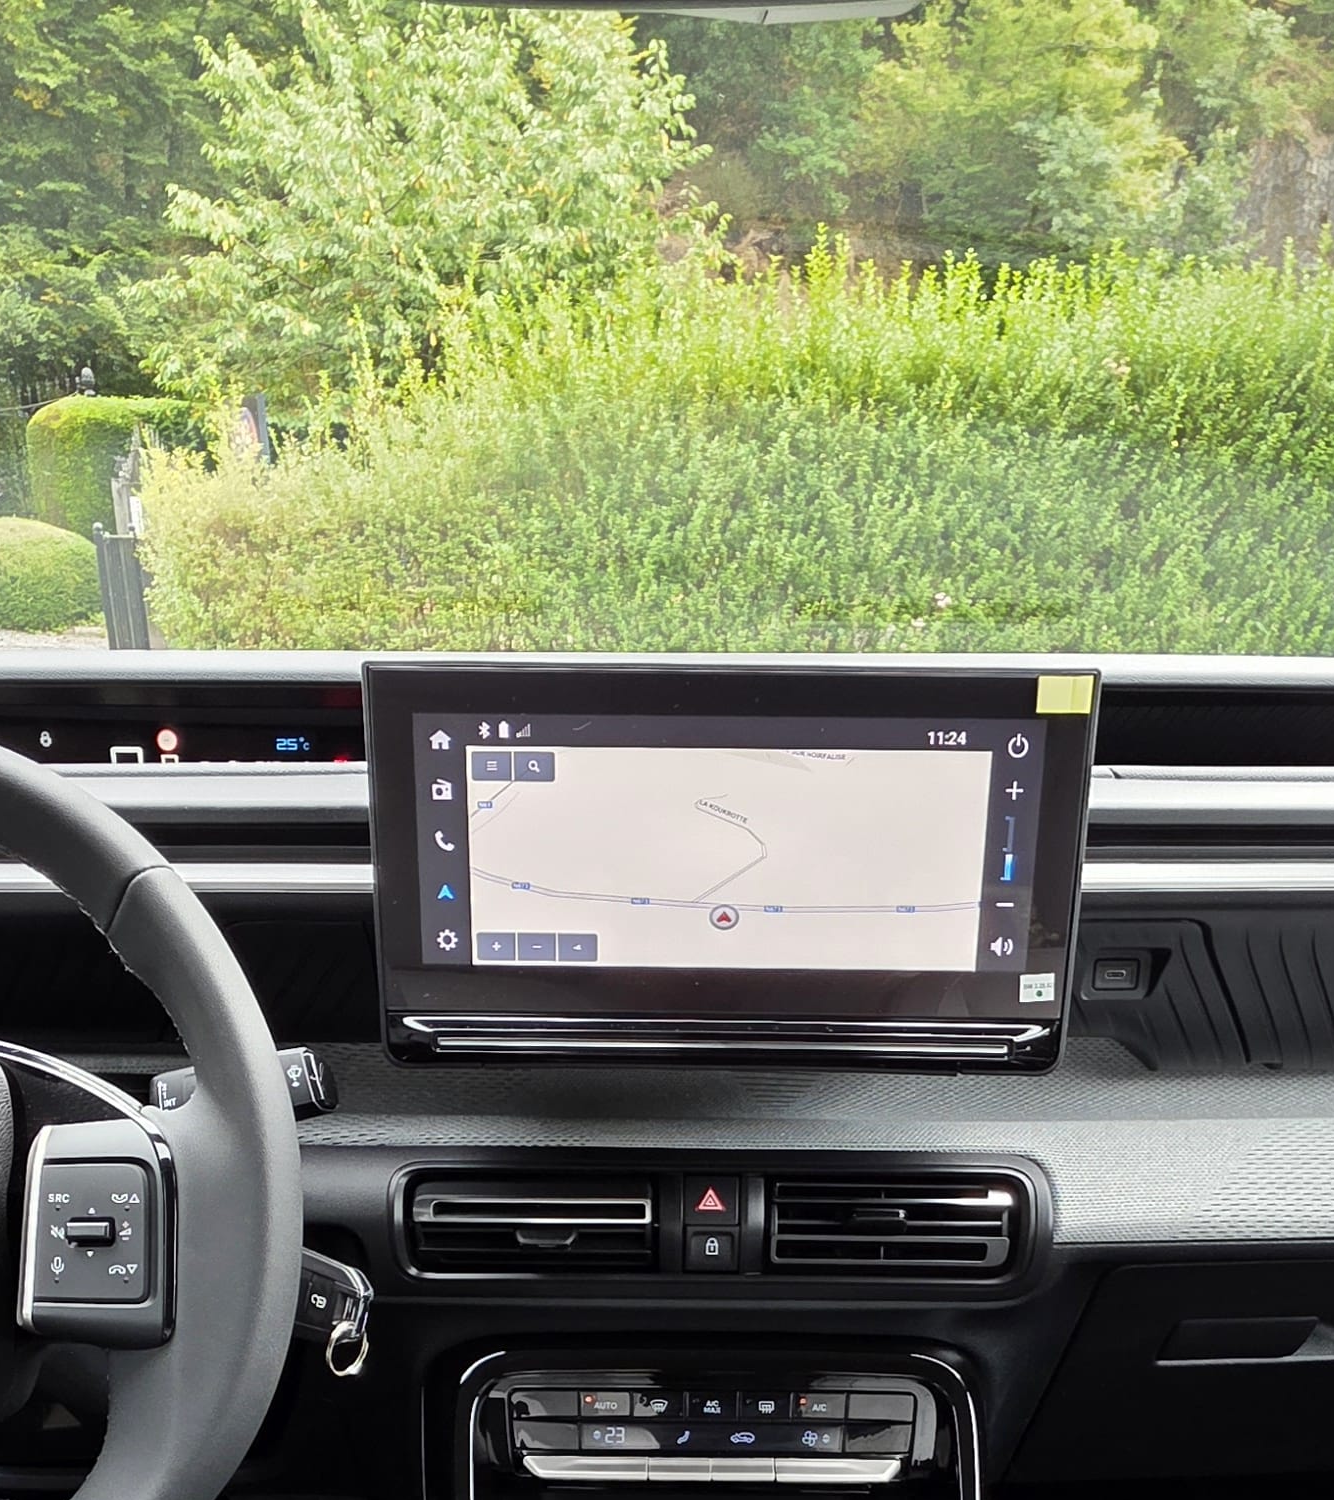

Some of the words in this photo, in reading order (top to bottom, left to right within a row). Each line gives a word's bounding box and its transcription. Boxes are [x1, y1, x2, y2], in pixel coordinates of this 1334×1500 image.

[927, 731, 967, 745] 11:24
[48, 1193, 70, 1203] SRC
[594, 1401, 618, 1410] AUTO
[812, 1404, 827, 1412] A/C
[605, 1427, 625, 1443] 23
